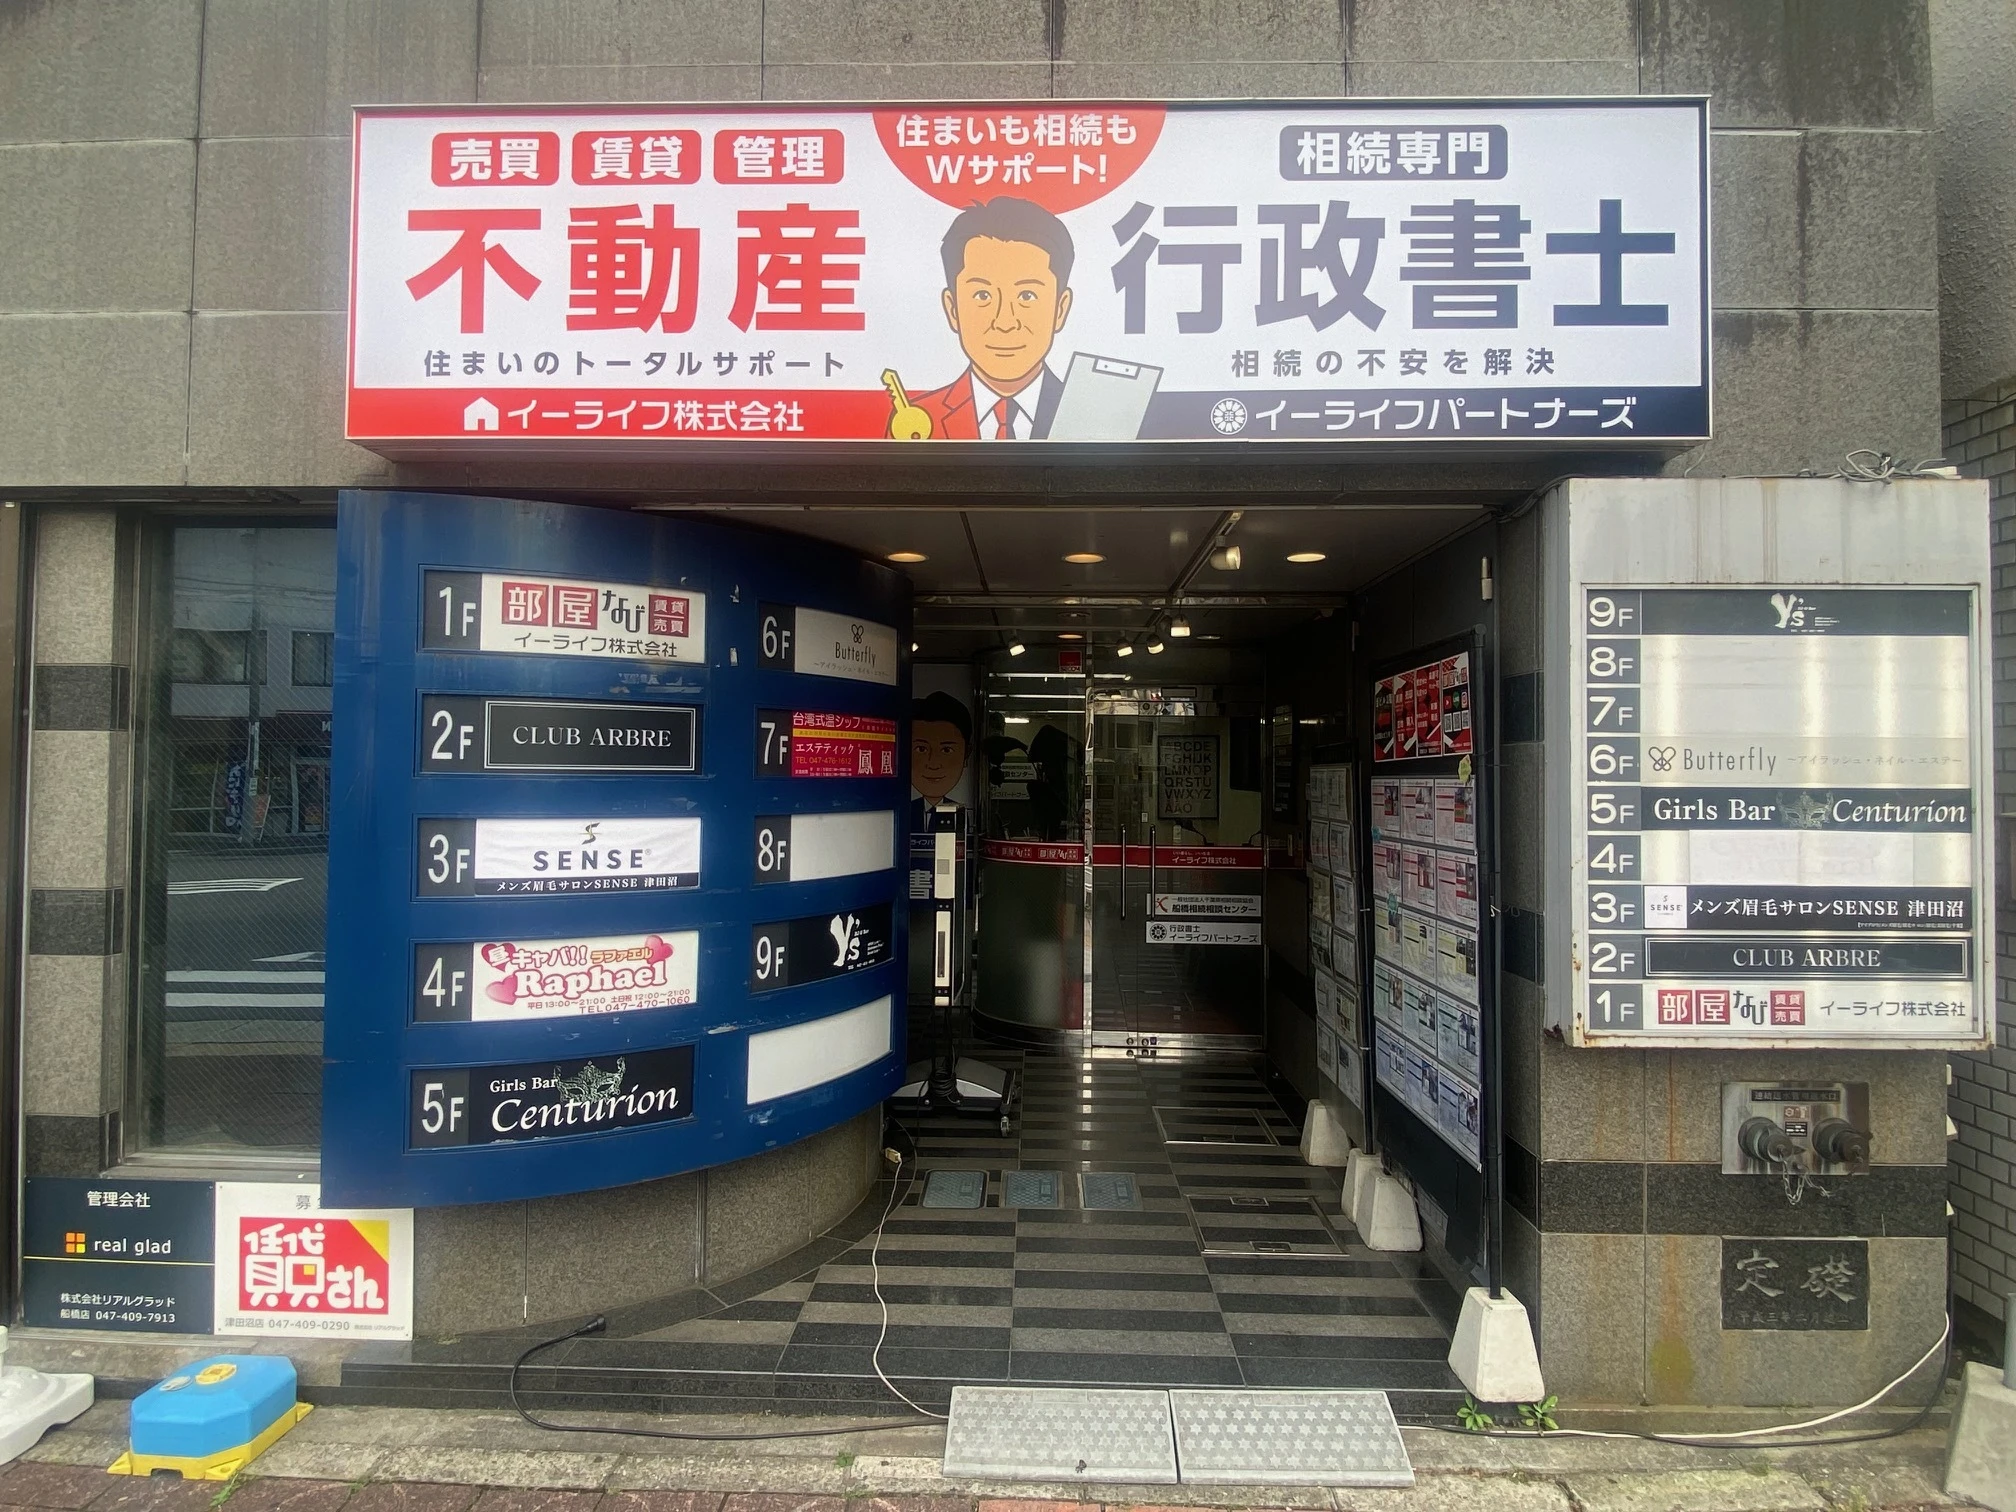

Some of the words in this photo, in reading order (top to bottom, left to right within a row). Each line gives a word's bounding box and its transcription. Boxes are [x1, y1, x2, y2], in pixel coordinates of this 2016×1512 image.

[896, 114, 1137, 147] 住まいも相続も
[449, 138, 541, 181] 売買
[591, 136, 683, 180] 賃貸
[733, 135, 825, 178] 管理
[926, 152, 1107, 184] Wサポート!
[1297, 131, 1491, 175] 相続専門
[405, 203, 866, 334] 不動産
[1110, 199, 1676, 335] 行政書士
[424, 349, 845, 377] 住まいのトータルサポート
[1231, 348, 1555, 377] 相続の不安を解決
[507, 400, 805, 432] イーライフ株式会社
[1256, 397, 1637, 430] イーライフパートナーズ
[439, 586, 476, 637] 1F
[653, 599, 685, 615] 賃貸
[1589, 597, 1633, 627] 9F
[653, 618, 684, 634] 売買
[762, 616, 791, 659] 6F
[514, 632, 678, 658] イーライフ株式会社
[835, 642, 876, 668] Butterfly
[1589, 646, 1633, 677] 8F
[793, 711, 861, 728] 台湾式温シップ
[1589, 696, 1633, 726] 7F
[431, 710, 474, 760] 2F
[512, 726, 581, 746] CLUB
[589, 728, 672, 747] ARBRE
[761, 722, 789, 765] 7F
[795, 742, 854, 754] エステティック
[1589, 744, 1633, 775] 6F
[1683, 748, 1776, 776] Butterfly
[1165, 777, 1212, 787] QRSTU
[1165, 789, 1212, 799] VWXYZ
[1590, 794, 1634, 824] 5F
[1654, 797, 1718, 821] Girls
[1729, 799, 1776, 821] Bar
[1832, 799, 1967, 824] Centurion
[428, 834, 470, 883] 3F
[758, 829, 786, 871] 8F
[1172, 856, 1237, 864] イーライフ株式会社
[1590, 842, 1634, 874] 4F
[496, 878, 638, 892] メンズ眉毛サロンSENSE
[644, 876, 678, 888] 津田沼
[1591, 892, 1635, 923] 3F
[1689, 898, 1899, 917] メンズ眉毛サロンSENSE
[1908, 900, 1964, 918] 津田沼
[1169, 925, 1200, 933] 行政書士
[590, 948, 653, 965] ラファエル
[756, 936, 785, 979] 9F
[1591, 943, 1635, 973] 2F
[1732, 948, 1794, 968] CLUB
[1801, 948, 1881, 968] ARBRE
[422, 957, 465, 1007] 4F
[514, 961, 667, 1000] Raphael
[527, 1001, 543, 1010] 平日
[611, 995, 632, 1003] 土日祝
[1596, 990, 1635, 1023] 1F
[1774, 1010, 1802, 1023] 売買
[1819, 1001, 1966, 1018] イーライフ株式会社
[489, 1079, 526, 1093] Girls
[532, 1077, 558, 1090] Bar
[421, 1083, 464, 1133] 5F
[491, 1084, 679, 1132] Centurion
[87, 1191, 151, 1208] 管理会社
[94, 1238, 127, 1252] real
[134, 1238, 171, 1255] glad
[60, 1292, 176, 1308] 株式会社リアルグラッド
[60, 1309, 91, 1321] 船橋店
[95, 1311, 176, 1324] 047-409-7913
[224, 1317, 265, 1330] 津田沼店
[268, 1319, 350, 1331] 047-409-0290
